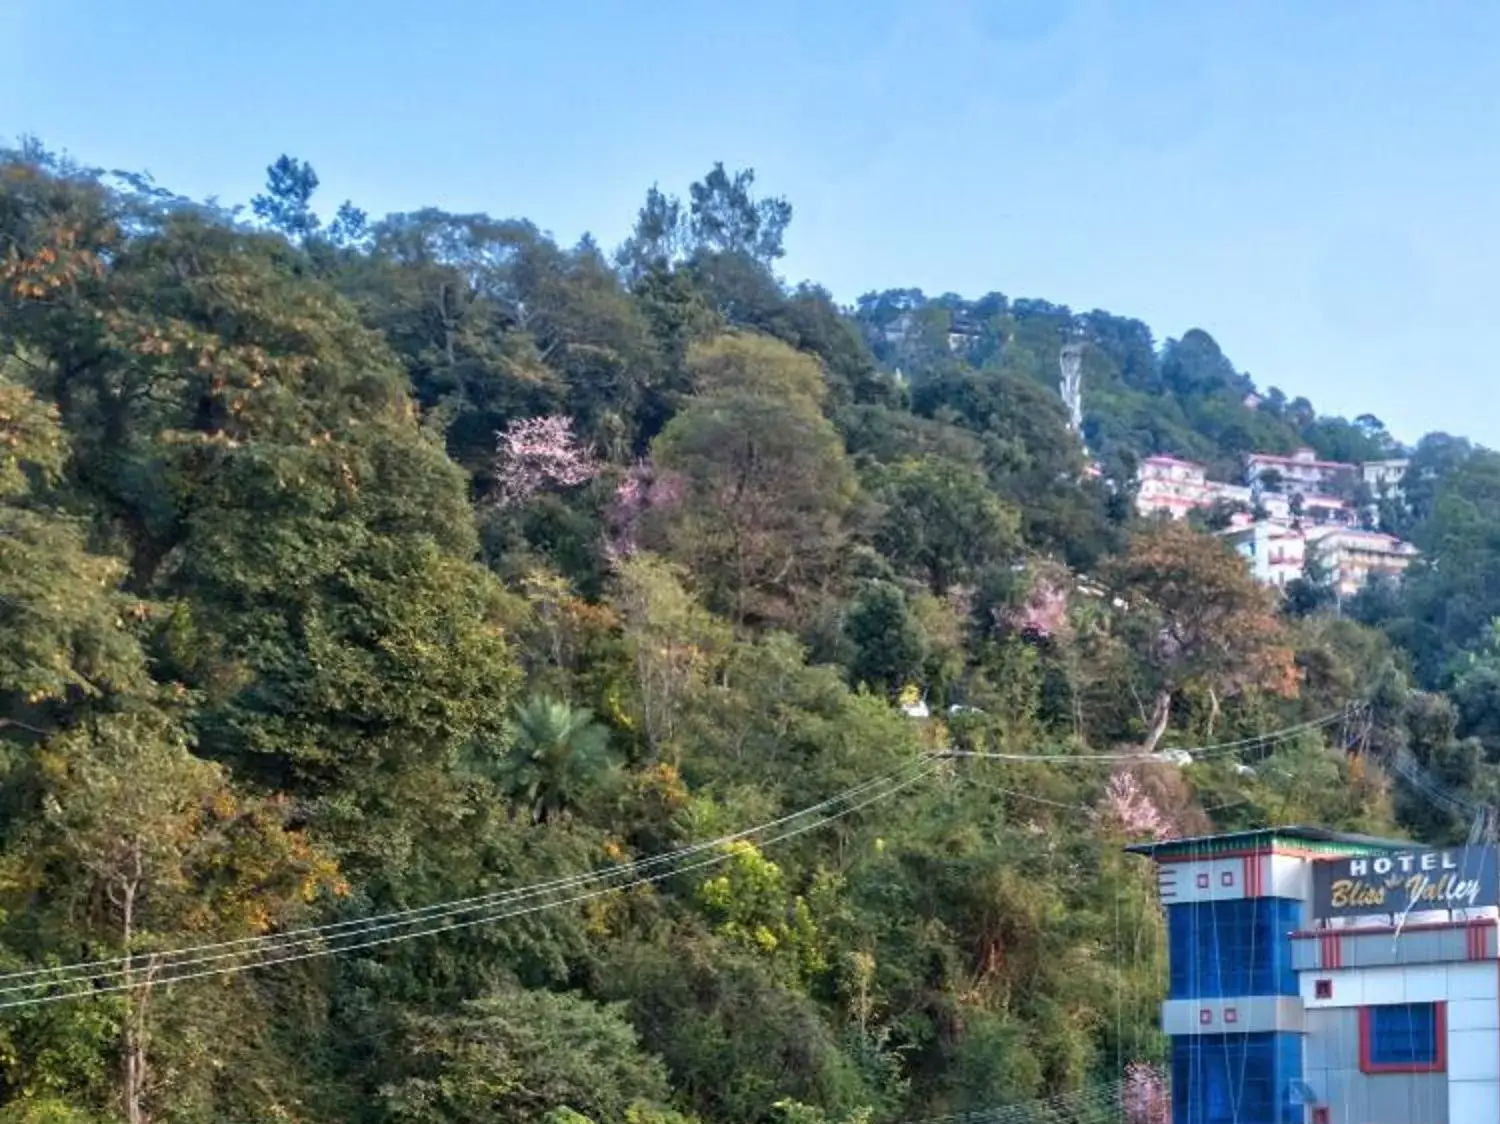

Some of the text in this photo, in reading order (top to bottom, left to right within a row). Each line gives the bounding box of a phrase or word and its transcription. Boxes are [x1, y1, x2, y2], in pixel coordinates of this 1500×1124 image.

[1351, 853, 1457, 876] HOTEL
[1331, 879, 1385, 907] Bliss
[1405, 873, 1480, 905] Valley
